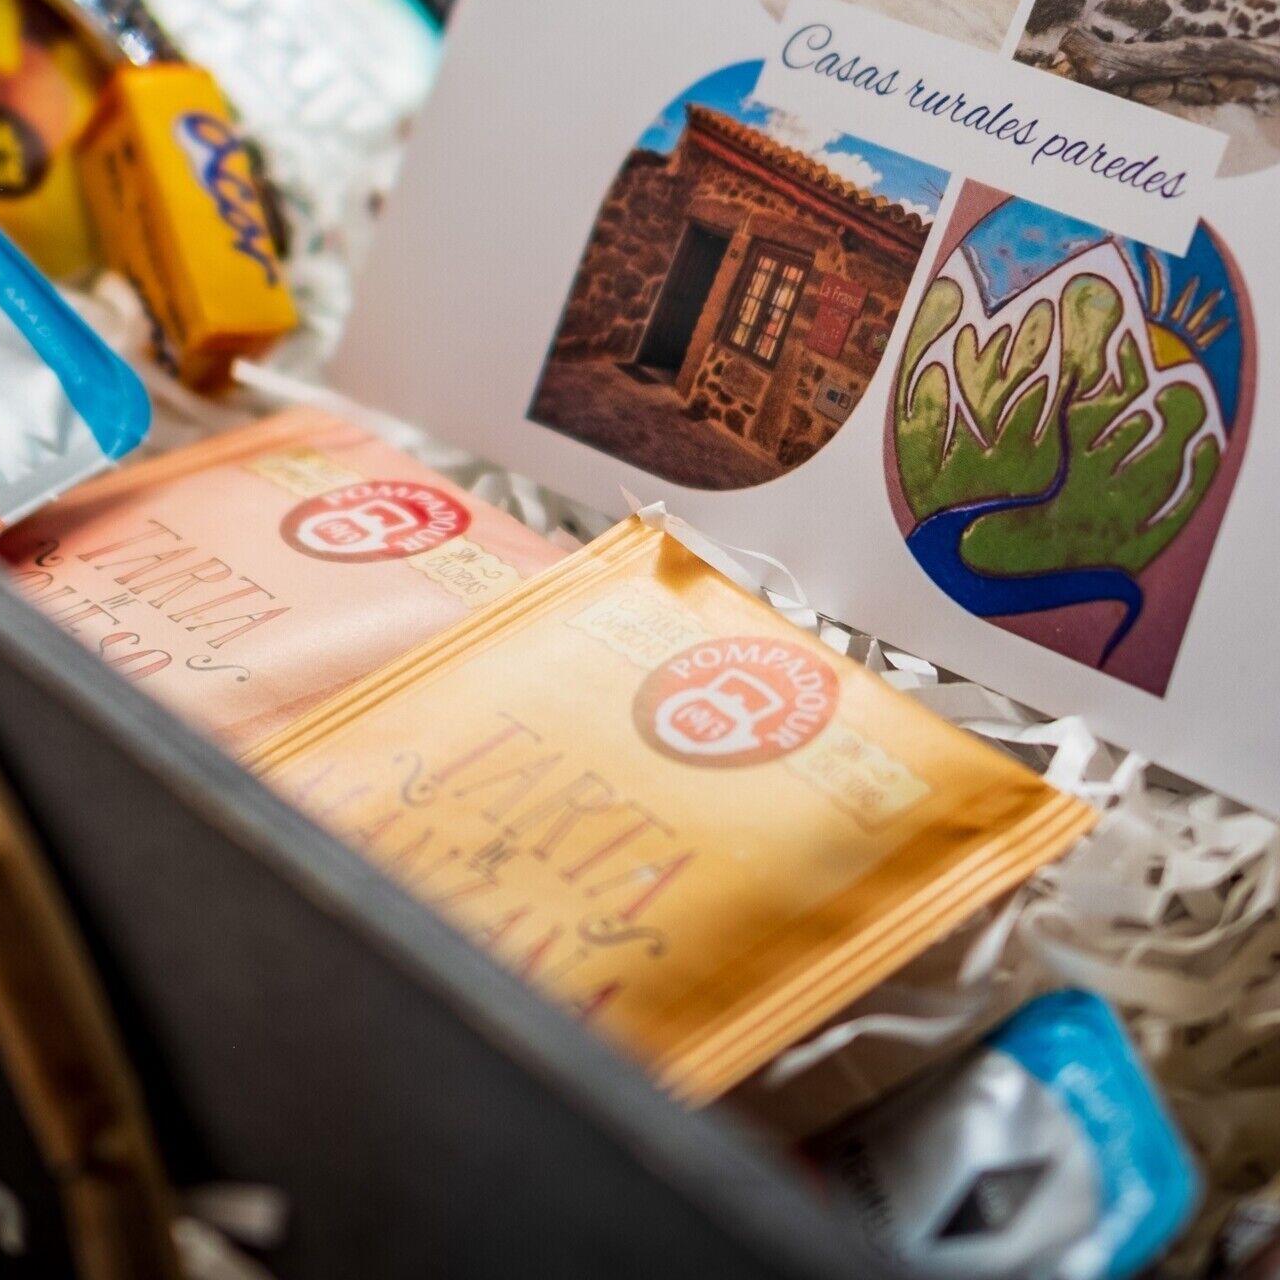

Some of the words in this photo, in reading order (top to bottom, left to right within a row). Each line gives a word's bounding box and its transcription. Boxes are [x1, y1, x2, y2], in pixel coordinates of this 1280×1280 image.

[781, 23, 900, 96] Casas
[904, 77, 1040, 147] rurales
[1029, 130, 1188, 202] paredes
[77, 518, 294, 651] TARTA
[670, 642, 827, 750] POMPADOUR
[429, 710, 704, 922] TARTA
